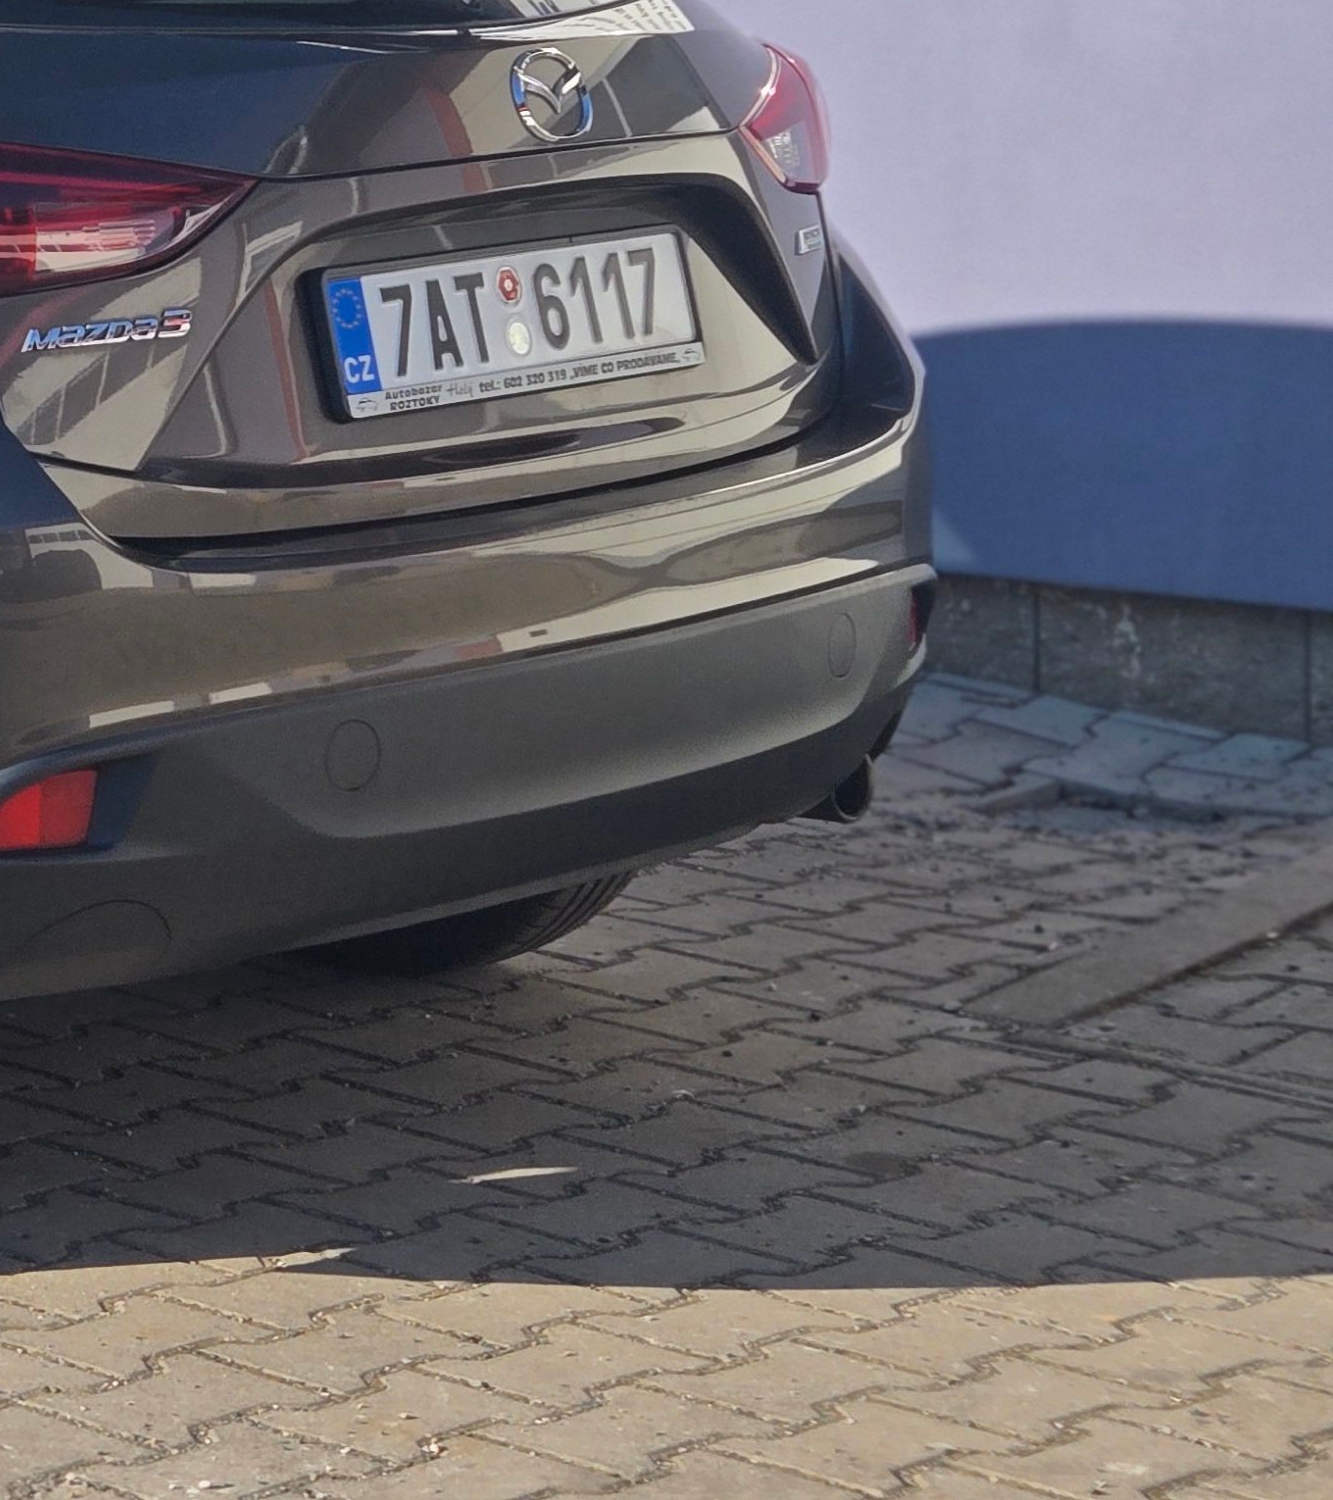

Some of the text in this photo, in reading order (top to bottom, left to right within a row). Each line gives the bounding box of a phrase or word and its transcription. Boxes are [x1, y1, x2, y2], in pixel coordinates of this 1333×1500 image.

[379, 247, 656, 378] 7AT 6117
[344, 353, 376, 383] CZ
[548, 368, 567, 383] 319
[390, 396, 440, 412] ROZTOKY
